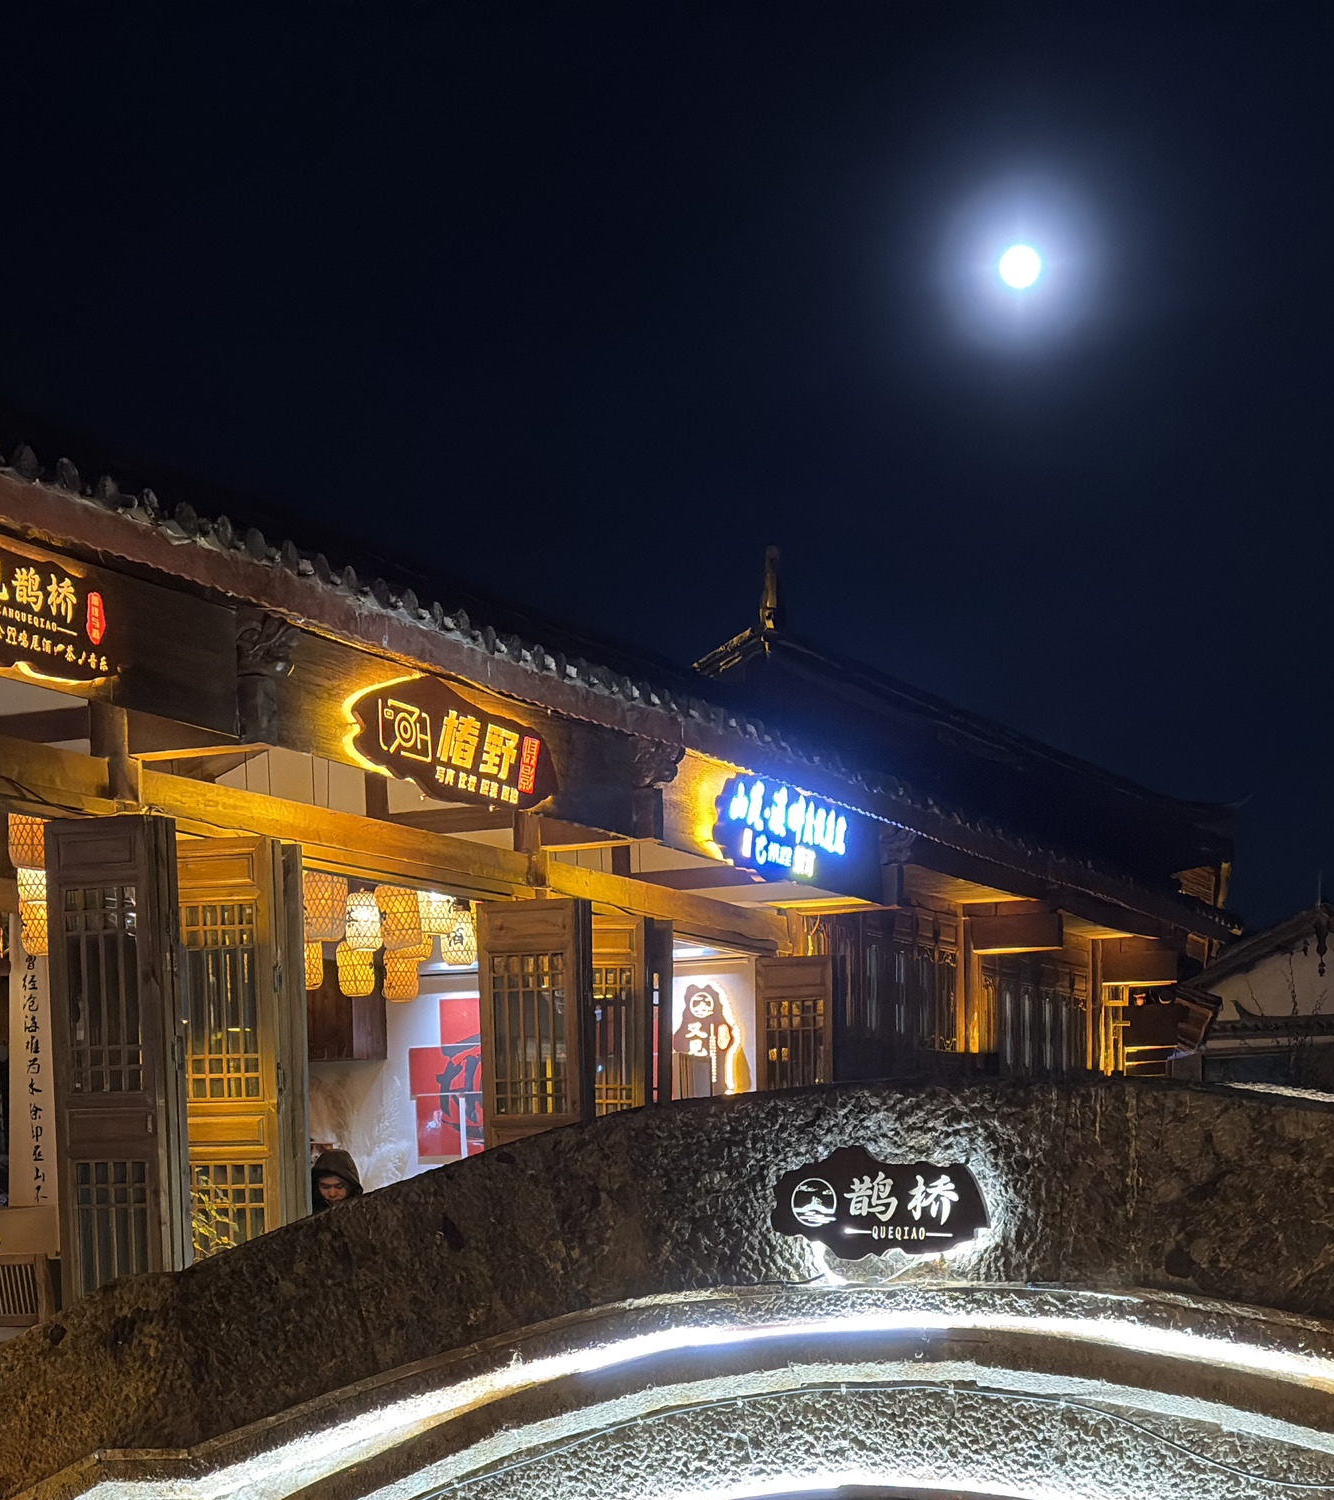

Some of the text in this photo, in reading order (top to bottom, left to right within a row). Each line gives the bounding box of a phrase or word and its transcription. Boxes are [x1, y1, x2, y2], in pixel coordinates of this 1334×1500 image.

[18, 629, 52, 655] 鸡尾酒
[65, 644, 77, 662] 茶
[87, 652, 109, 672] 音乐
[843, 1171, 960, 1226] 鹊桥
[871, 1225, 927, 1241] QUEQIAO
